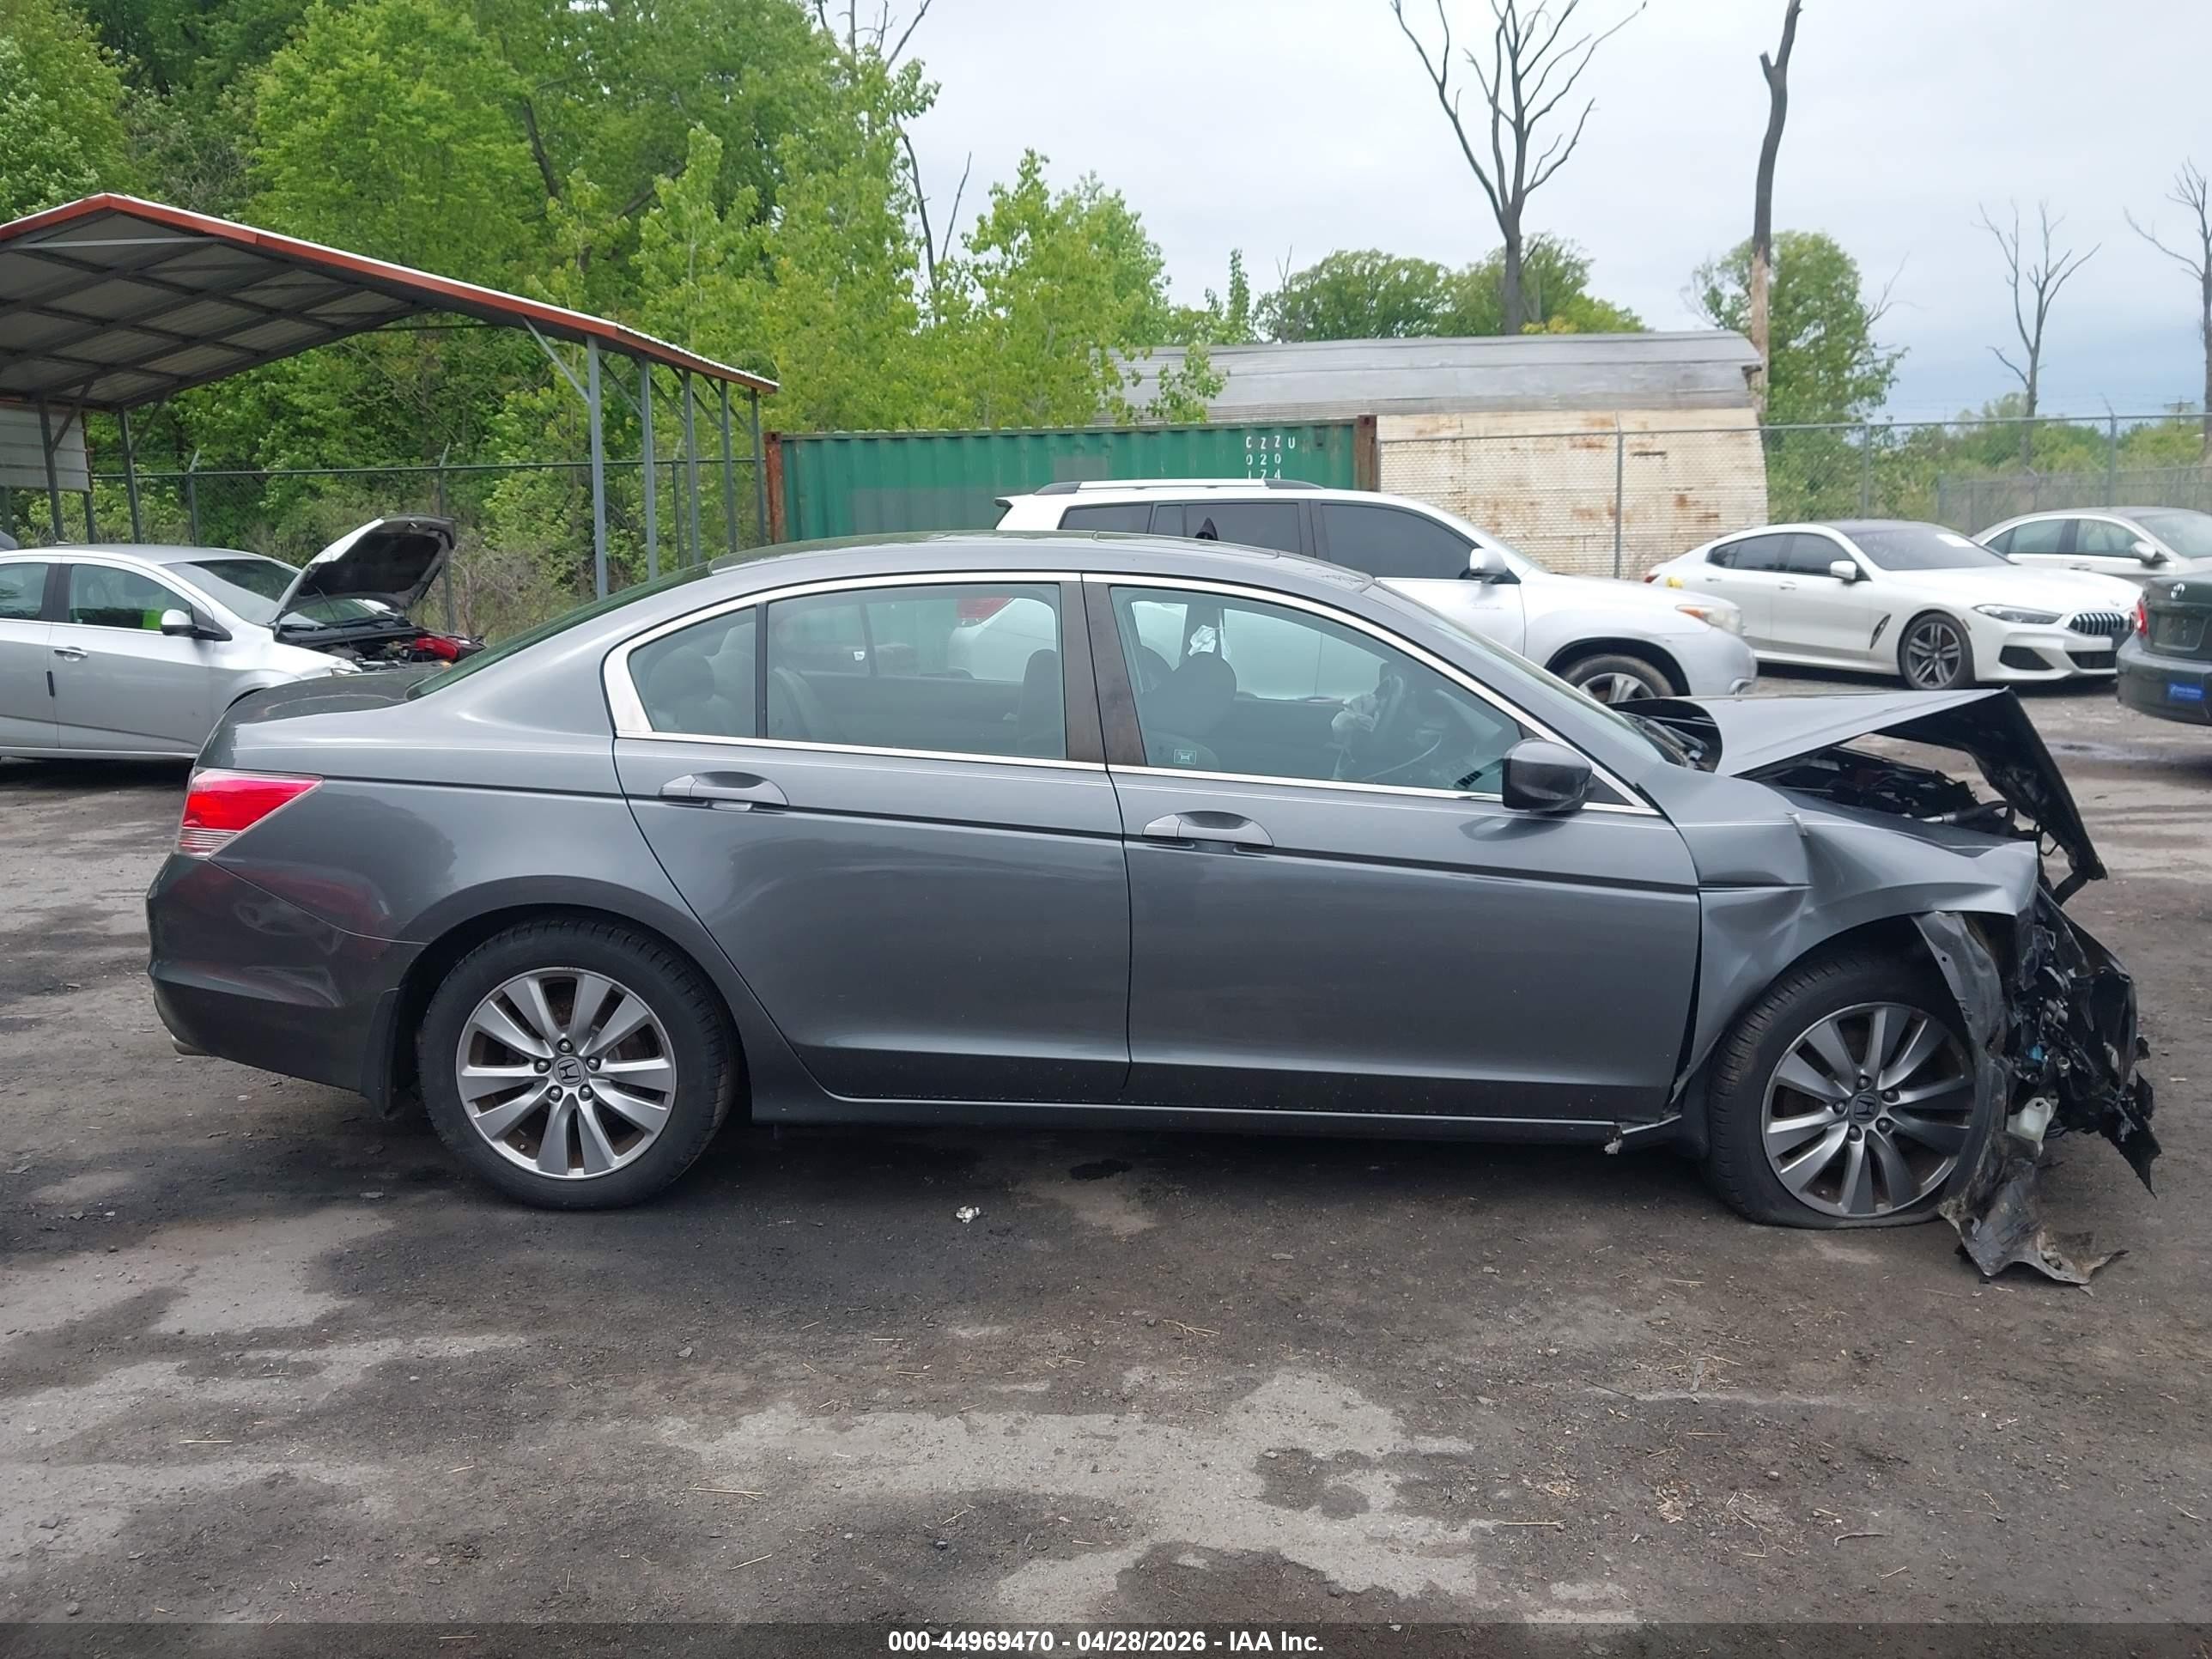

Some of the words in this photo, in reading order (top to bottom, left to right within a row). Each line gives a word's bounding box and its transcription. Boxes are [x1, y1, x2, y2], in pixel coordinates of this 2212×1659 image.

[1245, 434, 1296, 449] CZZU
[1245, 453, 1282, 465] 020
[1248, 468, 1281, 480] 174
